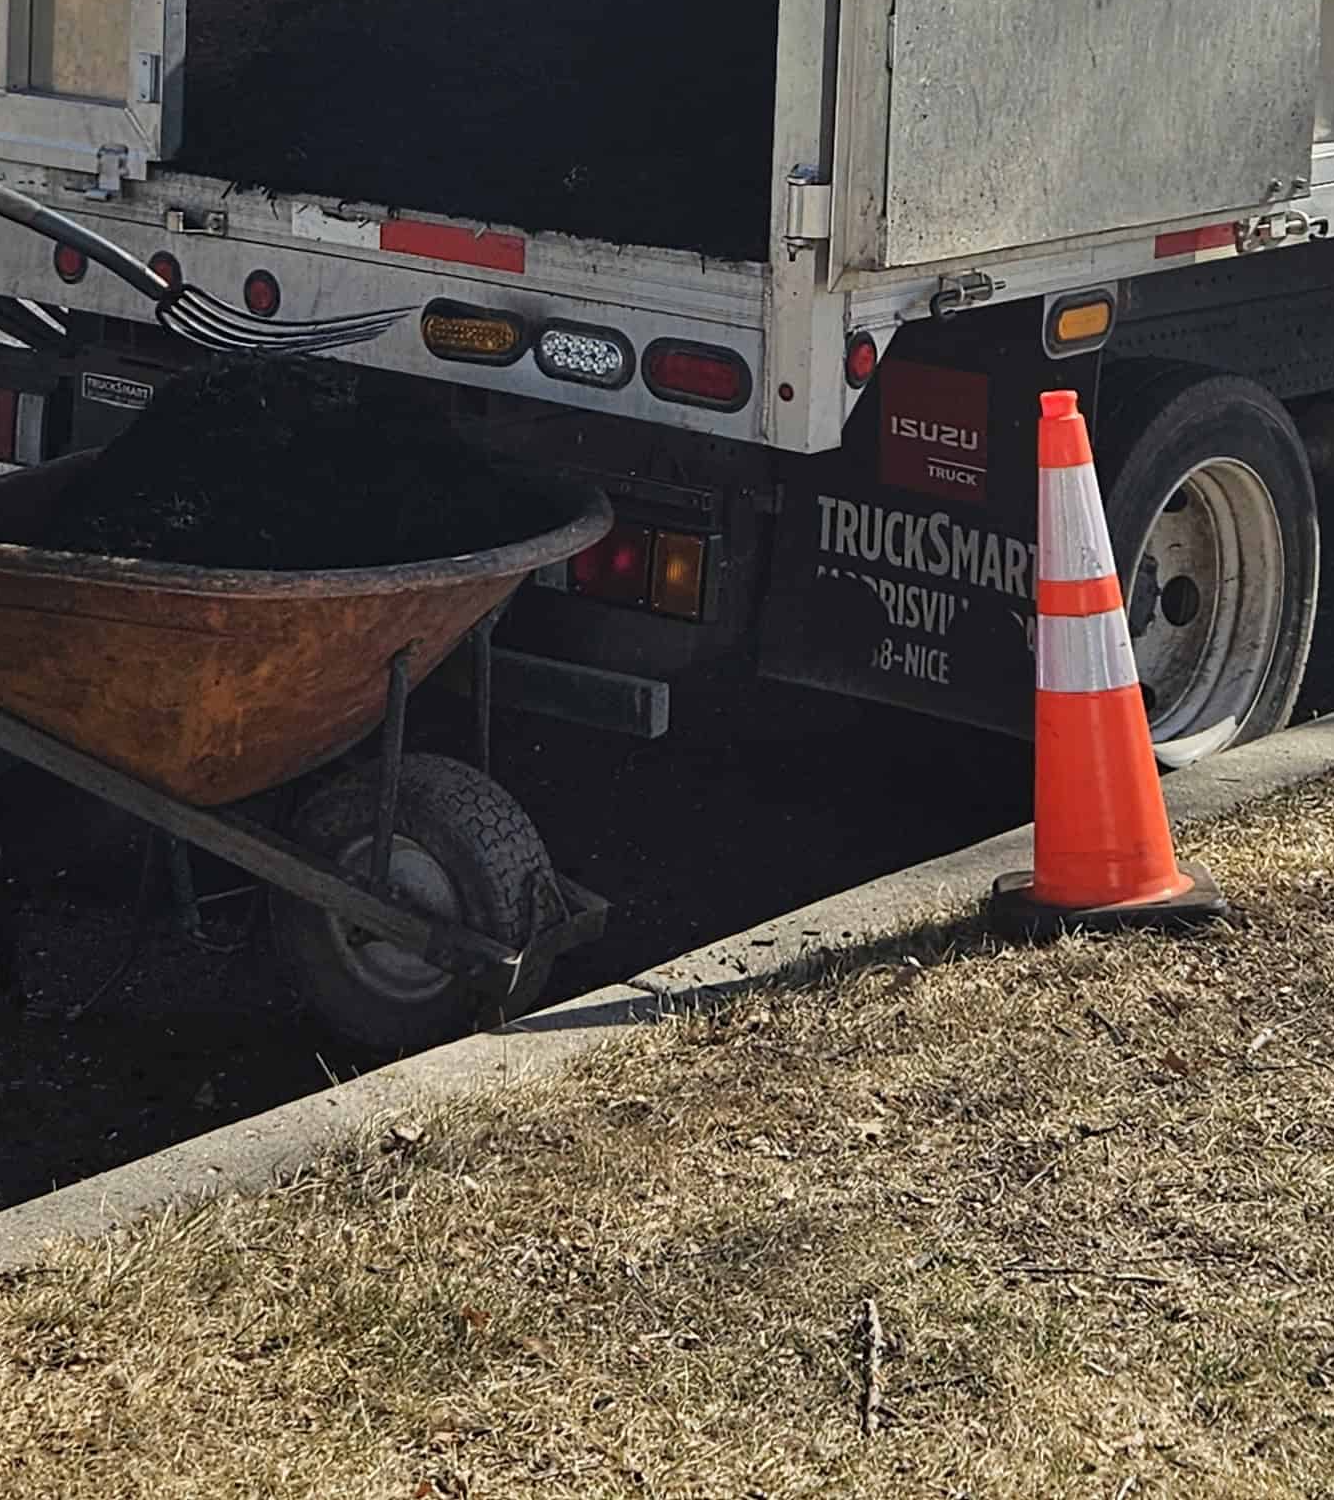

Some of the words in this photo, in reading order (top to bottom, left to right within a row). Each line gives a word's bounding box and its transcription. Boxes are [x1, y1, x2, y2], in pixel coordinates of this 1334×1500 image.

[890, 415, 979, 451] ISUZU
[927, 465, 978, 487] TRUCK
[871, 637, 950, 685] 8-NICE
